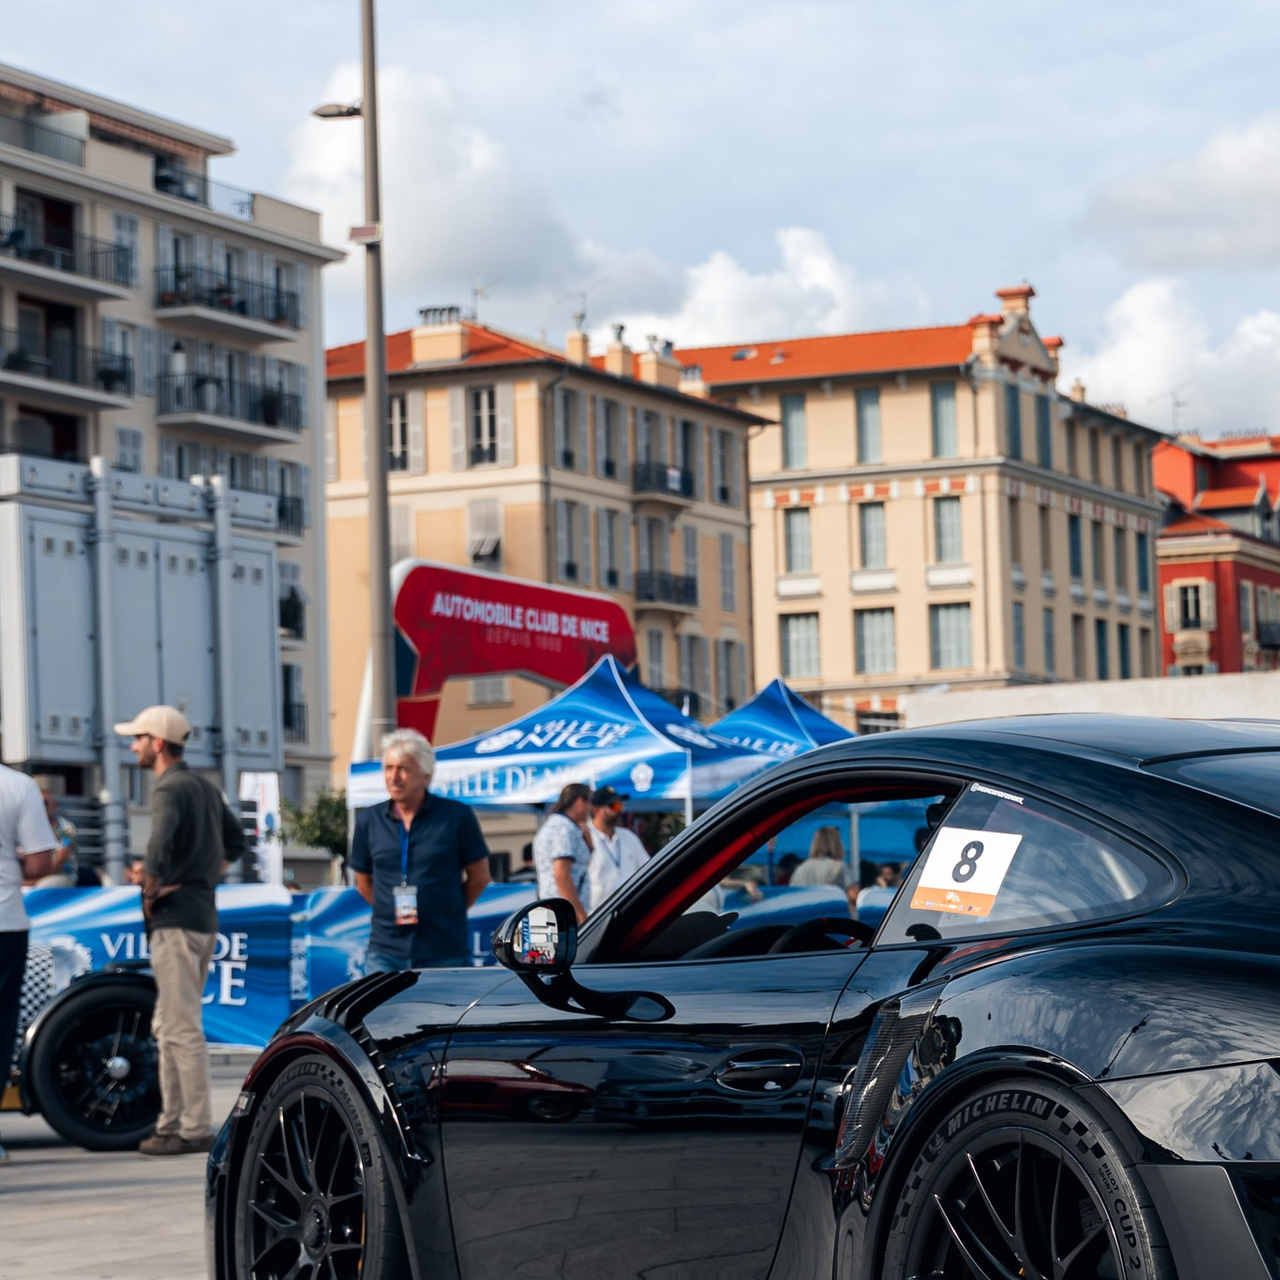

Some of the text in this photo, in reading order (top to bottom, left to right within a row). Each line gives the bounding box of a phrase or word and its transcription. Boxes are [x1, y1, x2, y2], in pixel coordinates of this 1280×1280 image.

[431, 591, 611, 643] AUTOMOBILE CLUB DE NICE
[516, 730, 623, 750] NICE
[952, 840, 984, 883] 8
[948, 1093, 1049, 1137] MICHELIN
[1101, 1162, 1120, 1192] PILOT
[1114, 1198, 1142, 1270] CUP 2
